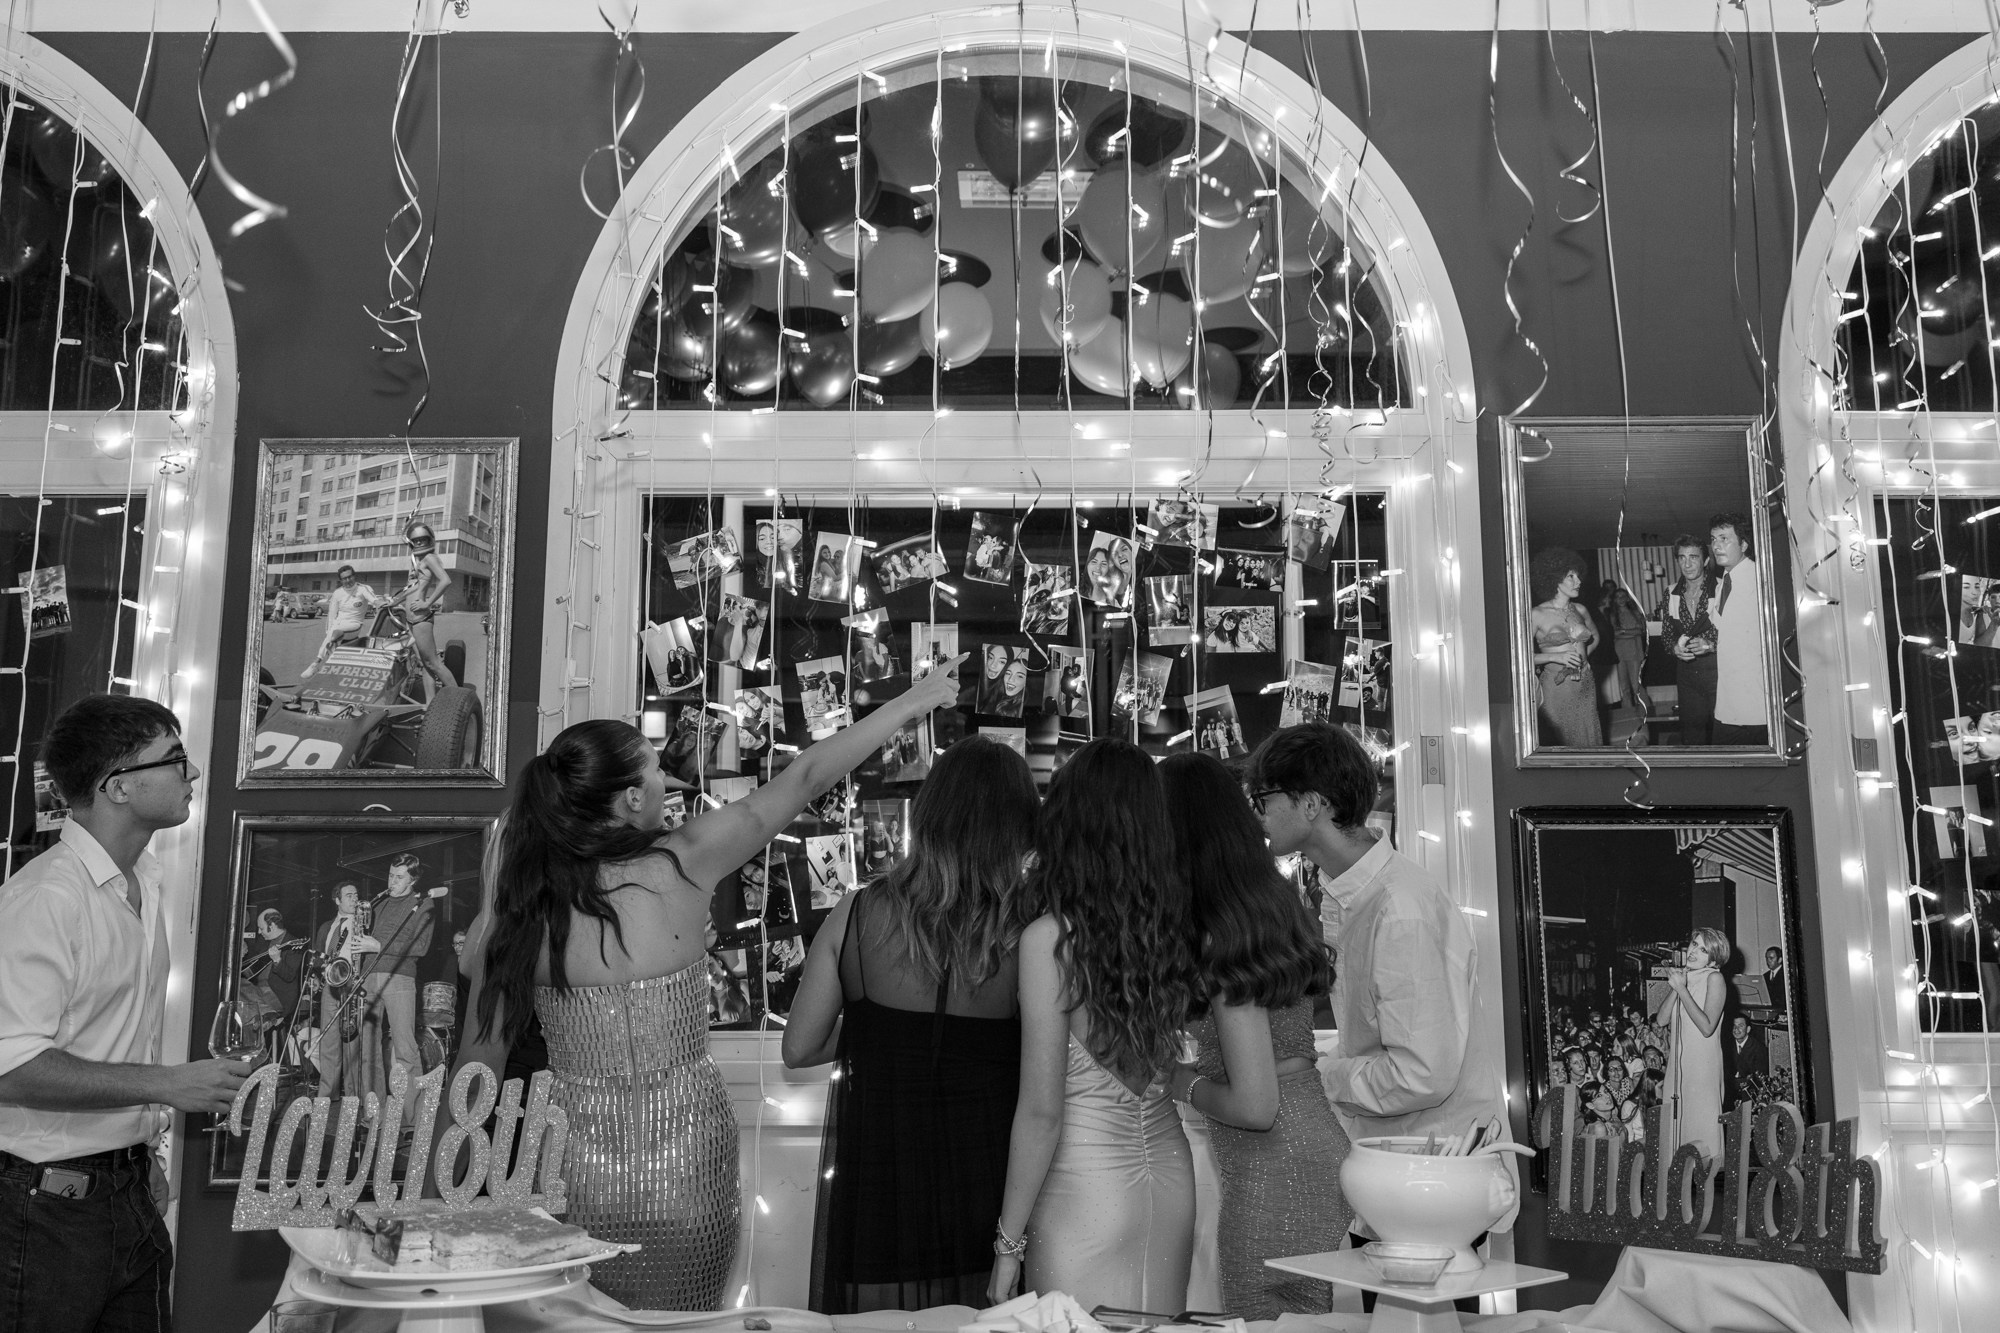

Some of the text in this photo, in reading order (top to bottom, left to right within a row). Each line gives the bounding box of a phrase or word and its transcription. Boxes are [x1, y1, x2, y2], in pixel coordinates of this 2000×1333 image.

[317, 666, 391, 681] EMBASSY
[338, 677, 385, 691] CLUB
[302, 687, 374, 702] rimini
